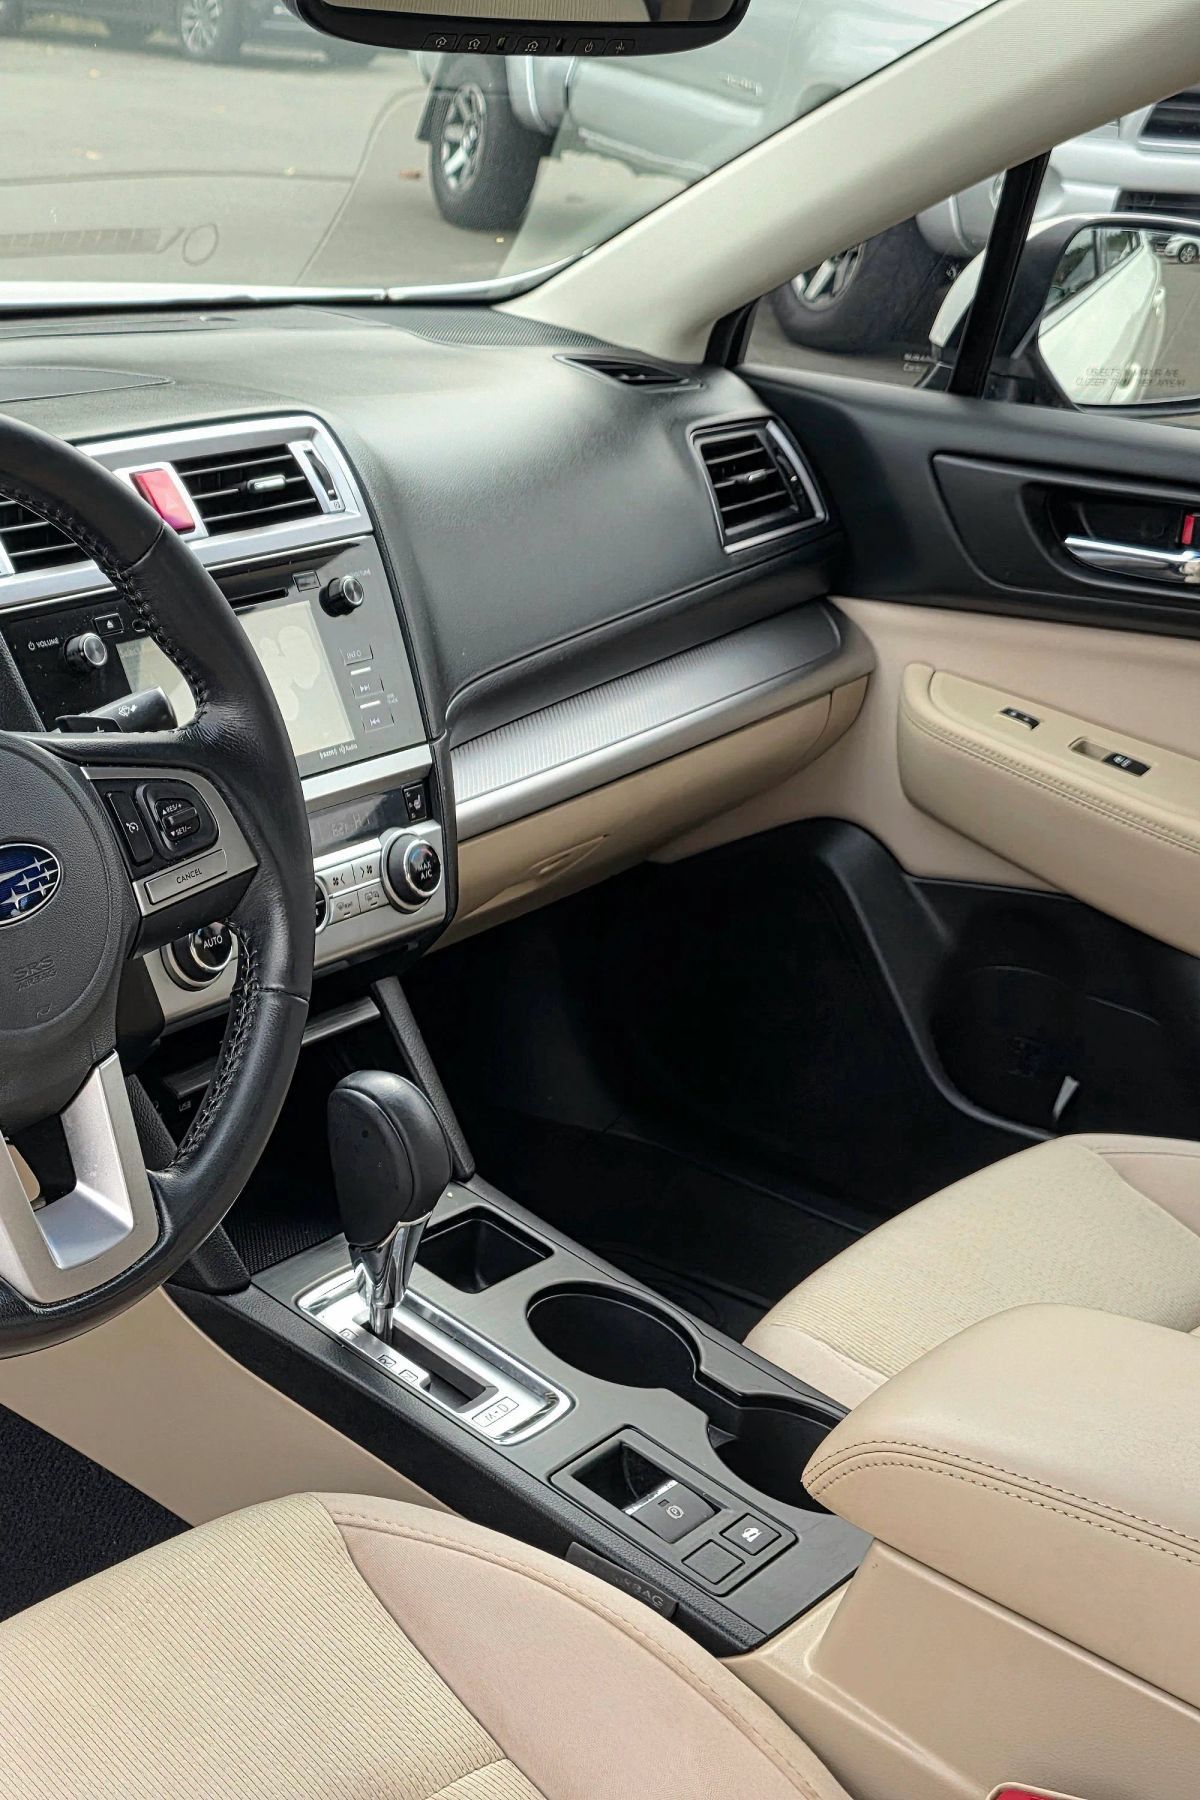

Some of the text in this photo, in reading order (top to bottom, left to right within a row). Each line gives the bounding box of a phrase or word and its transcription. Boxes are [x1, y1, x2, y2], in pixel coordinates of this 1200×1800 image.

[36, 637, 60, 649] VOLUME
[176, 868, 203, 884] CANCEL
[420, 871, 433, 880] A/C
[203, 934, 223, 949] AUTO
